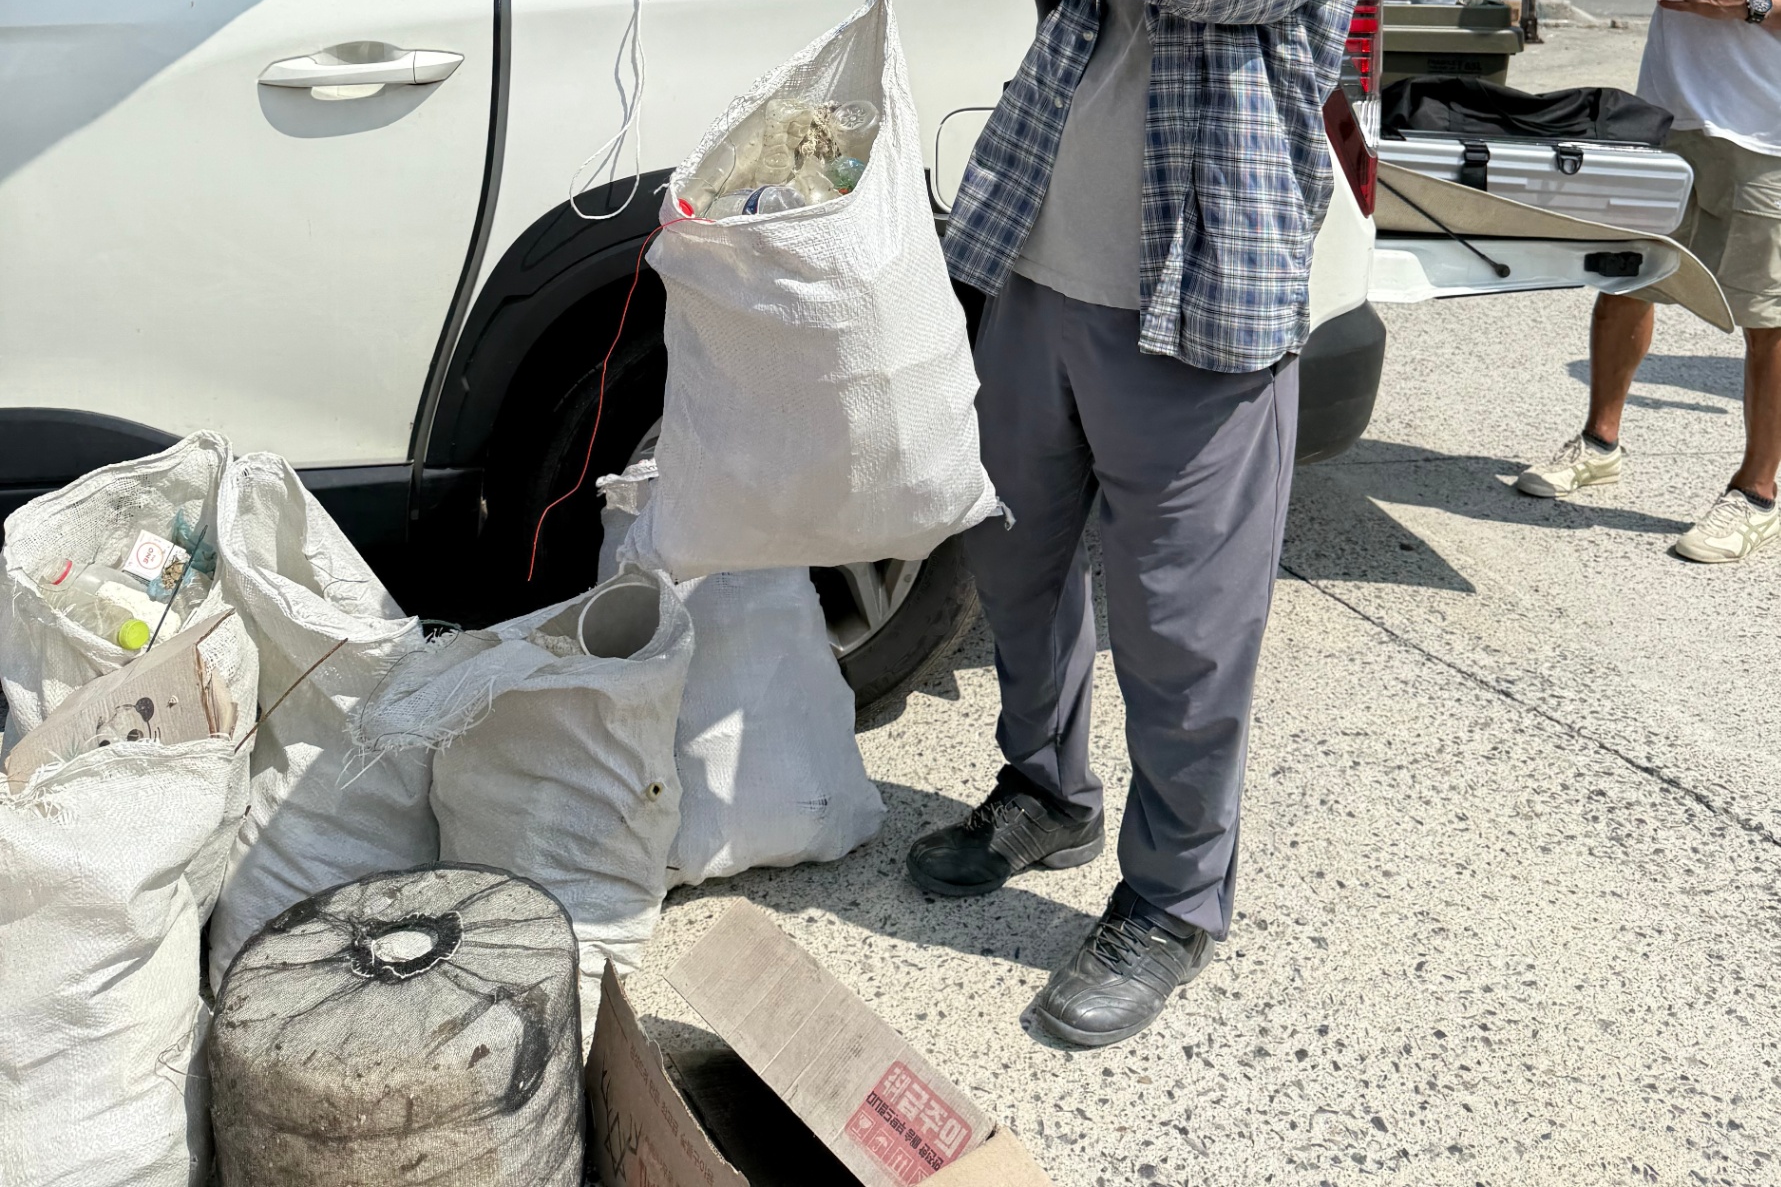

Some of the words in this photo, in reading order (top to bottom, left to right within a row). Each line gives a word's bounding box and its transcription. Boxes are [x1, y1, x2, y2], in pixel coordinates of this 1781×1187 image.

[865, 1090, 907, 1136] 부탁드립니다
[882, 1066, 969, 1159] 취급주의
[904, 1127, 923, 1150] 배송
